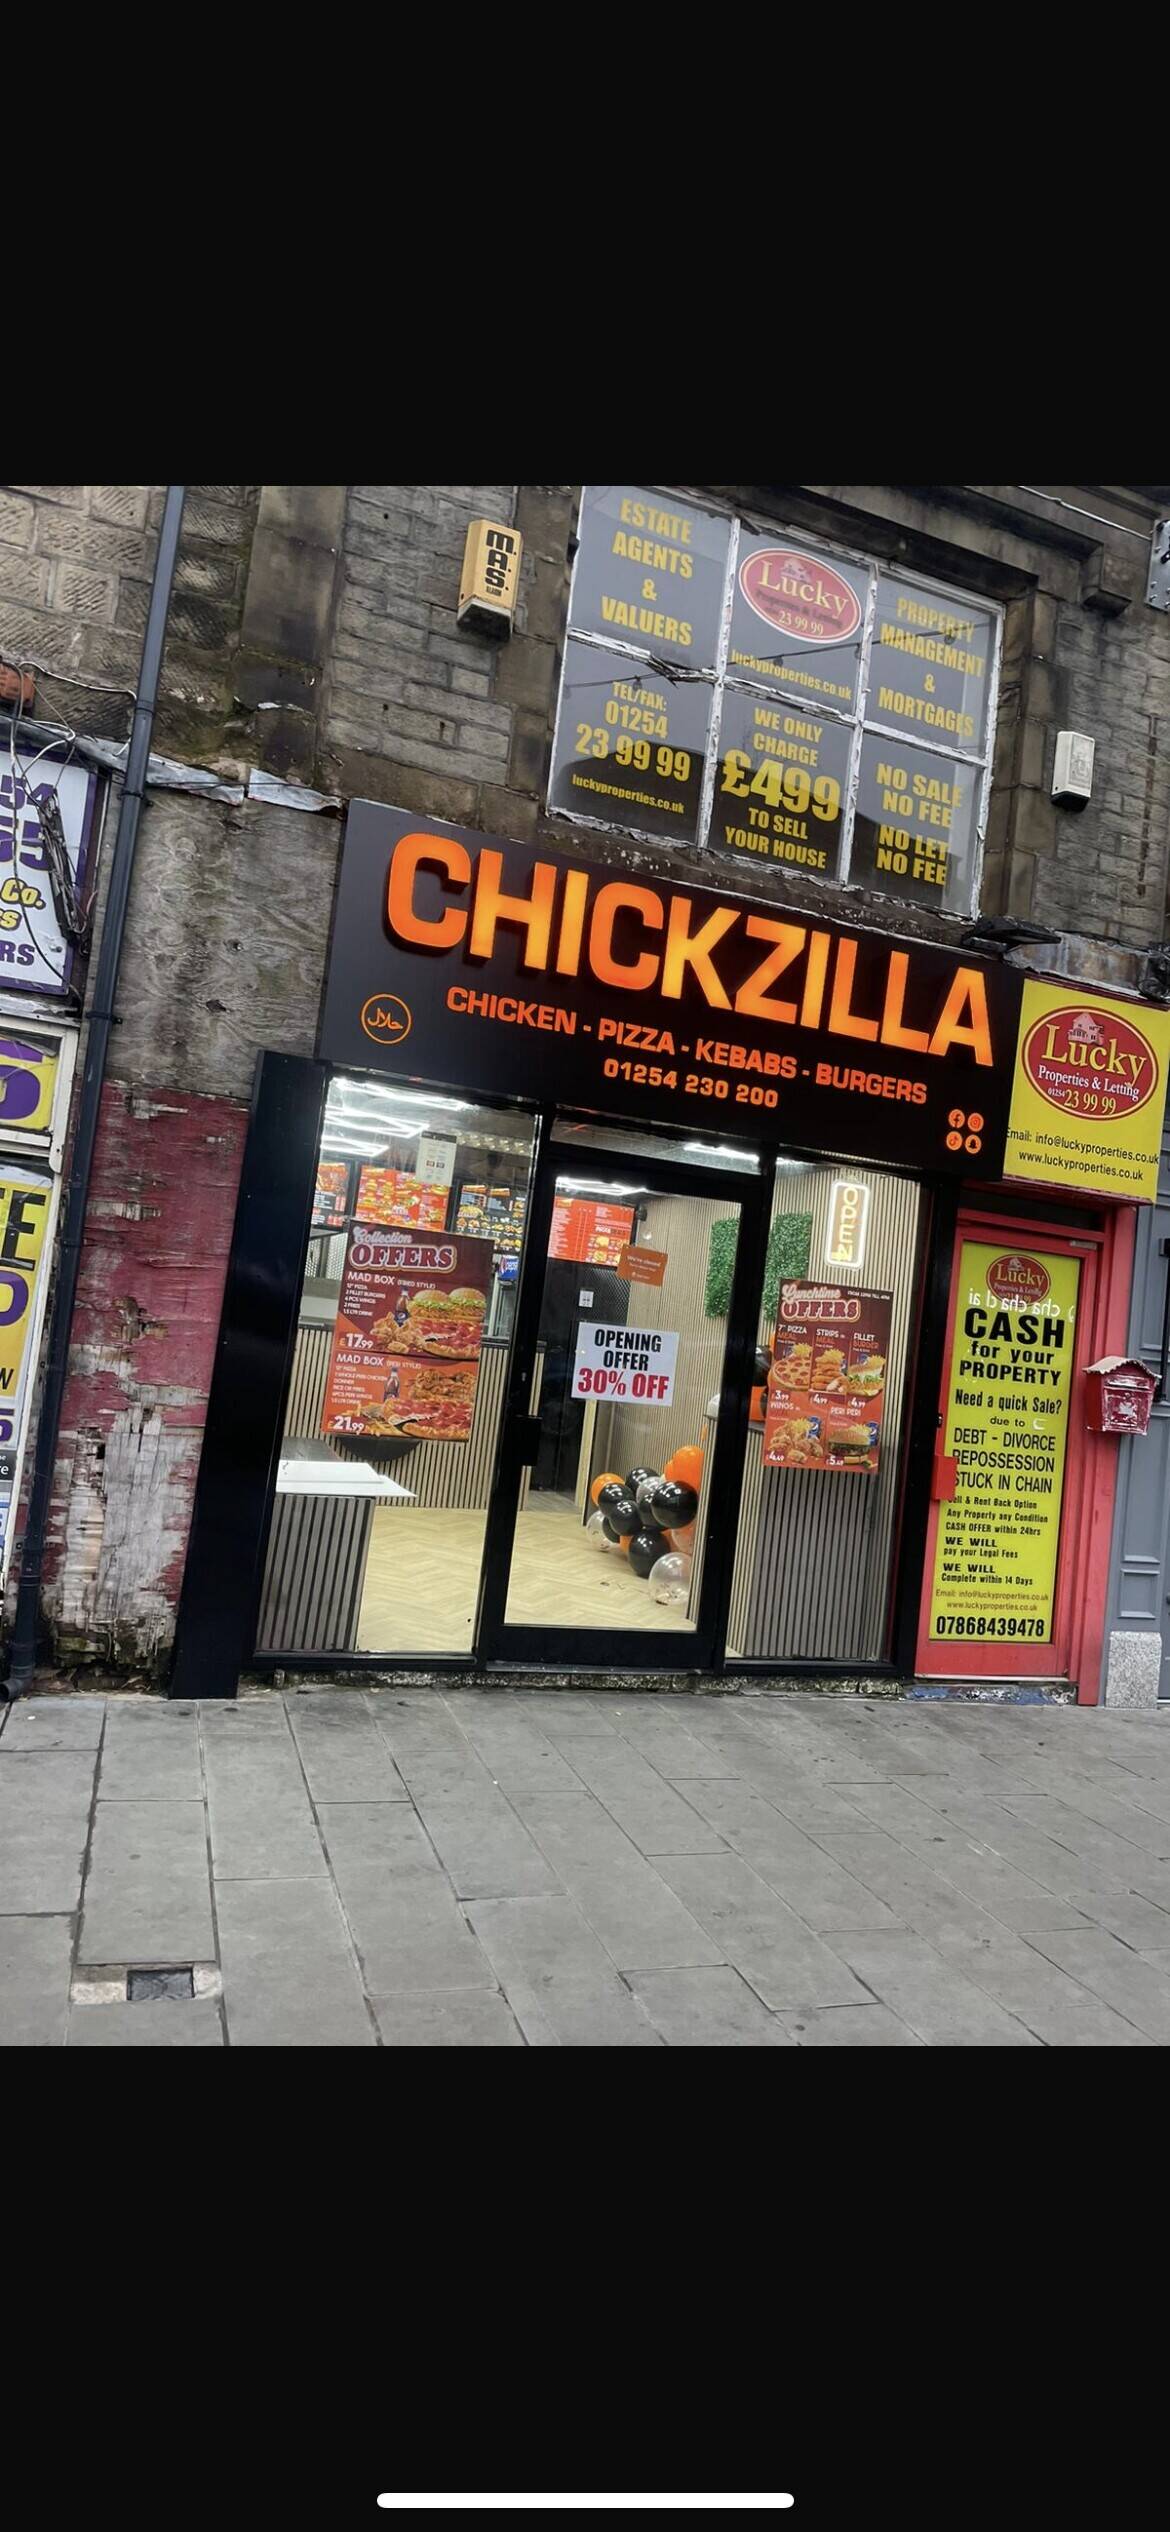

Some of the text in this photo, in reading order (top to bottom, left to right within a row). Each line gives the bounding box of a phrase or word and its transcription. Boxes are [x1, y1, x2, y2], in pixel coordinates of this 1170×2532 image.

[620, 498, 692, 545] ESTATE
[611, 531, 693, 579] AGENTS
[642, 579, 657, 601] &
[758, 560, 849, 620] Lucky
[601, 595, 694, 646] VALUERS
[779, 610, 824, 635] 23 99 99
[896, 597, 976, 643] PROPERTY
[880, 623, 985, 678] MANAGEMENT
[731, 649, 852, 700] luckyproperties.co.uk
[923, 673, 936, 694] &
[613, 681, 668, 712] TEL/FAX:
[605, 700, 668, 739] 01254
[755, 707, 824, 744] WE ONLY
[878, 686, 975, 737] MORTGAGES
[575, 723, 691, 781] 23 99 99
[753, 733, 818, 767] CHARGE
[572, 774, 685, 814] luckyproperties.co.uk
[721, 747, 841, 822] £499
[876, 762, 962, 808] NO SALE
[883, 789, 953, 828] NO FEE
[749, 807, 808, 840] TO SELL
[725, 826, 827, 869] YOUR HOUSE
[879, 824, 949, 862] NO LET
[876, 847, 948, 886] NO FEE
[0, 877, 46, 910] Co.
[387, 833, 994, 1067] CHICKZILLA
[446, 986, 577, 1035] CHICKEN
[598, 1018, 676, 1056] PIZZA
[695, 1038, 798, 1079] KEBABS
[815, 1062, 927, 1105] BURGERS
[1041, 1024, 1148, 1087] Lucky
[603, 1057, 779, 1108] 01254 230 200
[1038, 1064, 1140, 1102] Properties & Letting
[1047, 1087, 1116, 1115] 01254 23 99 99
[1006, 1127, 1159, 1164] Email: info@luckyproperties.co.uk
[1018, 1151, 1144, 1181] www.luckyproperties.co.uk
[353, 1226, 412, 1244] Collection
[838, 1187, 858, 1261] OPEN
[349, 1244, 456, 1272] OFFERS
[347, 1271, 371, 1282] MAD
[374, 1275, 395, 1285] BOX
[995, 1263, 1045, 1288] Lucky
[782, 1283, 841, 1302] Lunchtime
[781, 1300, 861, 1322] OFFERS
[340, 1333, 373, 1348] £17.99
[594, 1329, 662, 1353] OPENING
[787, 1325, 807, 1334] PIZZA
[816, 1329, 839, 1338] STRIPS
[854, 1333, 875, 1342] FILLET
[964, 1307, 1065, 1348] CASH
[336, 1353, 361, 1364] MAD
[363, 1356, 384, 1366] BOX
[603, 1350, 649, 1371] OFFER
[971, 1341, 1054, 1365] for your
[578, 1367, 669, 1400] 30% OFF
[960, 1360, 1061, 1387] PROPERTY
[955, 1389, 1062, 1414] Need a quick Sale?
[328, 1415, 364, 1431] £21.99
[990, 1416, 1025, 1427] due to
[954, 1427, 987, 1445] DEBT
[1003, 1432, 1056, 1451] DIVORCE
[998, 1474, 1011, 1490] IN
[1015, 1476, 1053, 1493] CHAIN
[947, 1509, 1048, 1523] Any Property any Condition
[974, 1497, 991, 1506] Rent
[994, 1498, 1011, 1507] Back
[1014, 1500, 1037, 1509] Option
[945, 1536, 998, 1547] WE WILL
[946, 1522, 1041, 1536] CASH OFFER within 24hrs
[943, 1548, 1018, 1558] pay your Legal Fees
[941, 1573, 1033, 1586] Complete within 14 Days
[943, 1563, 996, 1573] WE WILL
[936, 1616, 1045, 1636] 07868439478
